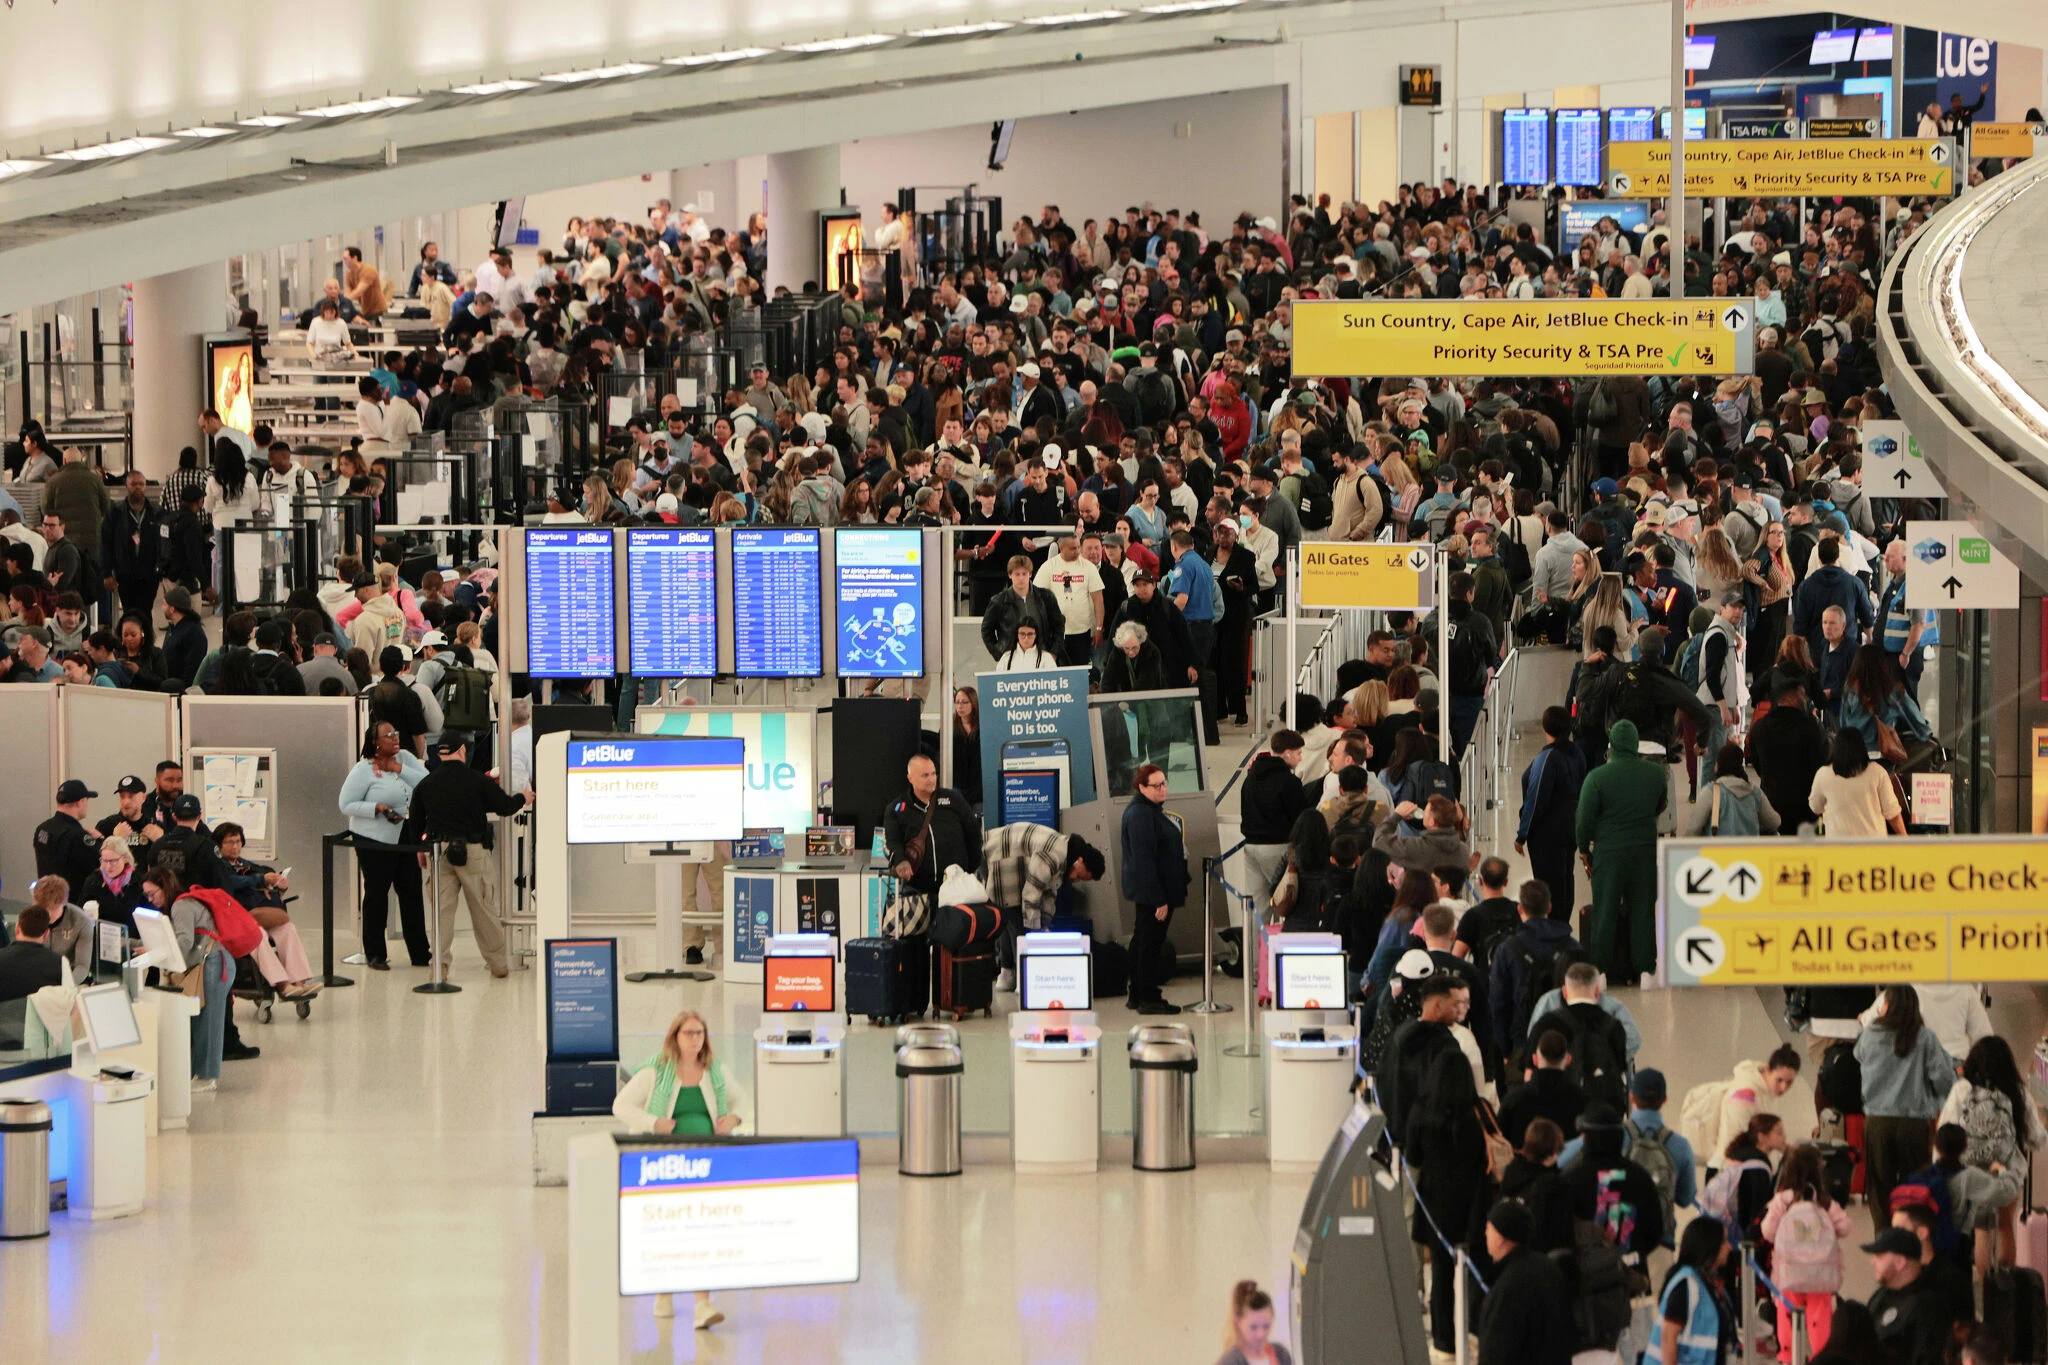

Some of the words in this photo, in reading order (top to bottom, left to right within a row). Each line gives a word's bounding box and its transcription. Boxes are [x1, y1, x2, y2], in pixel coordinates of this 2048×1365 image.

[1731, 126, 1750, 136] TSA
[1752, 126, 1768, 136] Pre
[1975, 127, 1986, 135] All
[1987, 127, 2010, 135] Gates
[1648, 151, 1671, 161] Sun
[1684, 151, 1731, 163] ountry,
[1737, 151, 1769, 162] Cape
[1773, 151, 1794, 162] Air,
[1798, 149, 1844, 160] JetBlue
[1848, 148, 1904, 160] Check-in
[1656, 174, 1670, 184] Al
[1684, 174, 1714, 185] ates
[1754, 172, 1801, 187] Priority
[1806, 171, 1857, 185] Security
[1862, 173, 1872, 183] &
[1877, 172, 1902, 183] TSA
[1906, 173, 1927, 183] Pre
[1343, 313, 1375, 328] Sun
[1381, 313, 1456, 331] Country,
[1463, 313, 1506, 331] Cape
[1511, 313, 1540, 329] Air,
[1546, 312, 1608, 327] JetBlue
[1614, 311, 1688, 327] Check-in
[1434, 345, 1496, 363] Priority
[1503, 344, 1572, 362] Security
[1578, 344, 1591, 358] &
[1596, 344, 1630, 358] TSA
[1636, 344, 1663, 358] Pre
[1585, 362, 1624, 370] Seguridad
[530, 533, 568, 542] Departures
[576, 533, 609, 545] jetBlue
[632, 533, 670, 541] Departures
[678, 532, 710, 545] jetBlue
[737, 533, 762, 541] Arrivals
[783, 532, 815, 545] jetBlue
[1307, 553, 1325, 565] All
[1329, 553, 1369, 566] Gates
[1961, 549, 1987, 558] MINT
[997, 678, 1058, 693] Everything
[1059, 677, 1068, 689] is
[992, 698, 1007, 708] on
[1008, 697, 1034, 710] your
[1036, 693, 1074, 708] phone.
[1007, 710, 1032, 722] Now
[1035, 708, 1061, 721] your
[1011, 724, 1023, 735] ID
[1025, 723, 1035, 734] is
[1036, 723, 1058, 734] too.
[581, 745, 635, 766] jetBlue
[748, 762, 796, 791] ue
[583, 779, 621, 792] Start
[626, 778, 659, 791] here
[1916, 781, 1945, 789] PLEASE
[1824, 865, 1936, 892] JetBlue
[1948, 863, 2048, 891] Check-
[1792, 926, 1832, 952] All
[1846, 927, 1937, 952] Gates
[1792, 962, 1831, 974] Todas
[1835, 961, 1854, 973] las
[1858, 961, 1913, 975] puertas
[639, 1154, 712, 1186] jetBlue
[642, 1203, 693, 1222] Start
[700, 1202, 744, 1218] here
